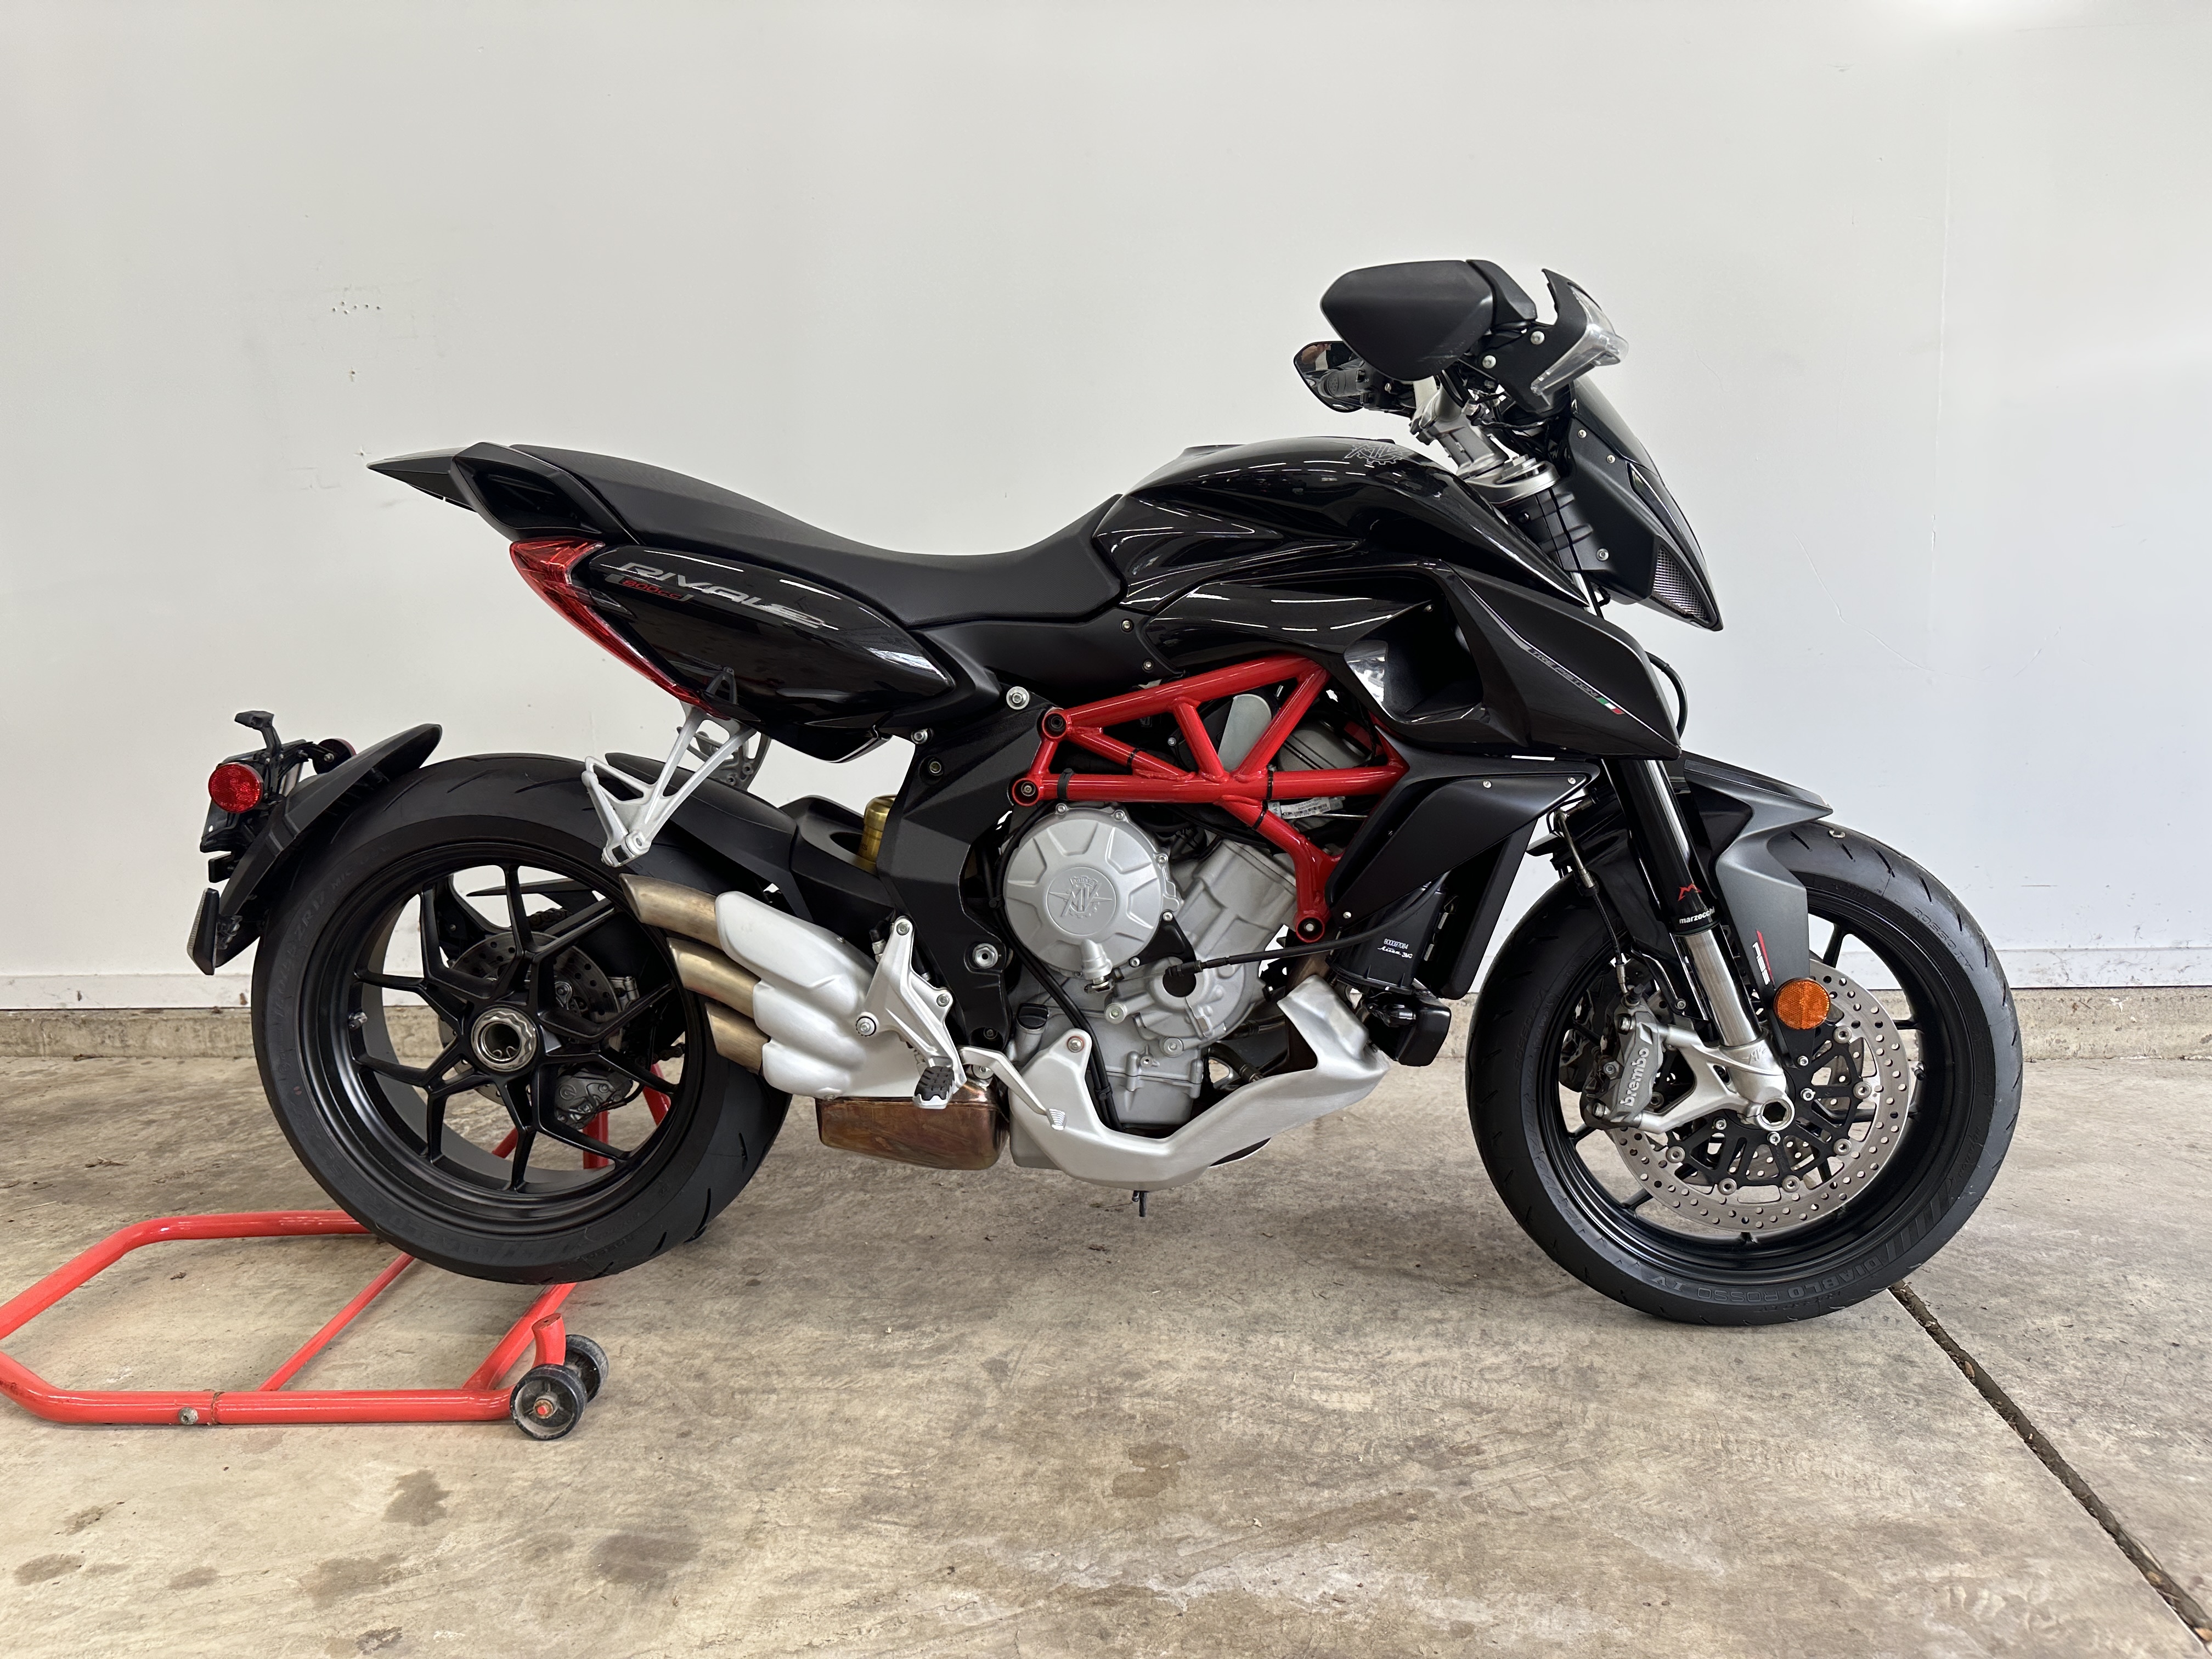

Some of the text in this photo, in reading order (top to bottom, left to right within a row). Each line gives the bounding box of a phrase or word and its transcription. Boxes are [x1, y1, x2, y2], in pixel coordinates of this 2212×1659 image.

[619, 562, 823, 629] RIVALE
[622, 579, 682, 600] 800cc
[1554, 667, 1599, 697] PISTONI
[1679, 906, 1716, 924] marzocchi
[1620, 1047, 1650, 1107] brembo
[1651, 1273, 1685, 1293] IV
[1787, 1254, 1884, 1299] DIABLO
[1696, 1286, 1779, 1302] ROSSO
